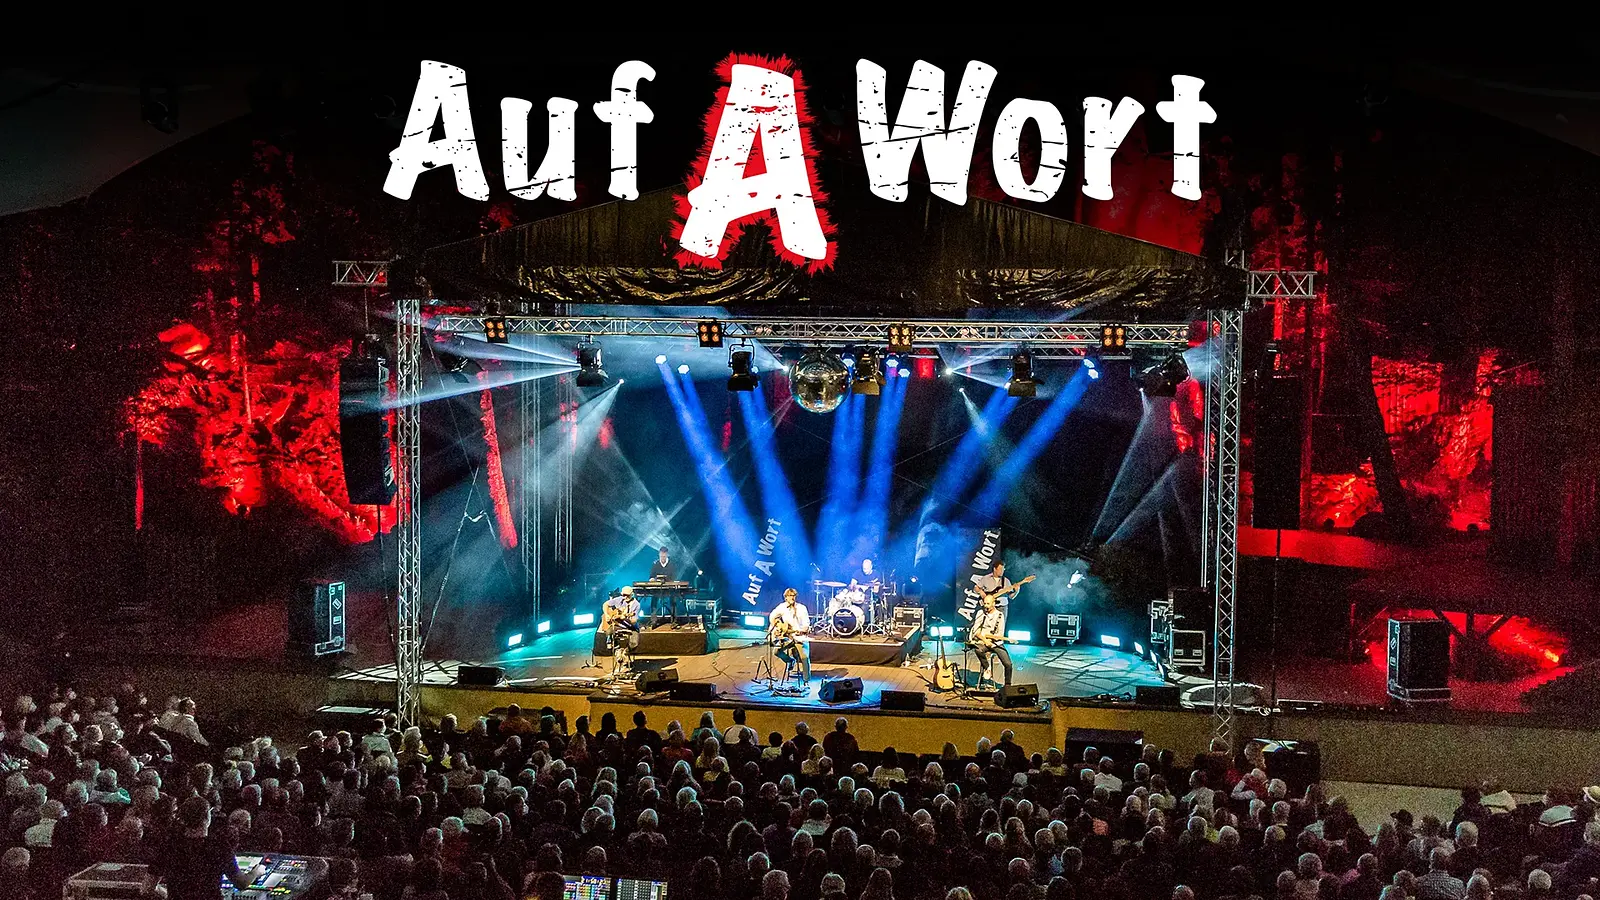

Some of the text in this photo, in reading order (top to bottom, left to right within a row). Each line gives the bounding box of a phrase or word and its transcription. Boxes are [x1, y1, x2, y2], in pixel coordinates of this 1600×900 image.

[757, 518, 782, 556] Wort
[754, 560, 776, 577] A
[957, 588, 980, 621] Auf
[972, 530, 1000, 570] Wort
[742, 573, 763, 605] Auf
